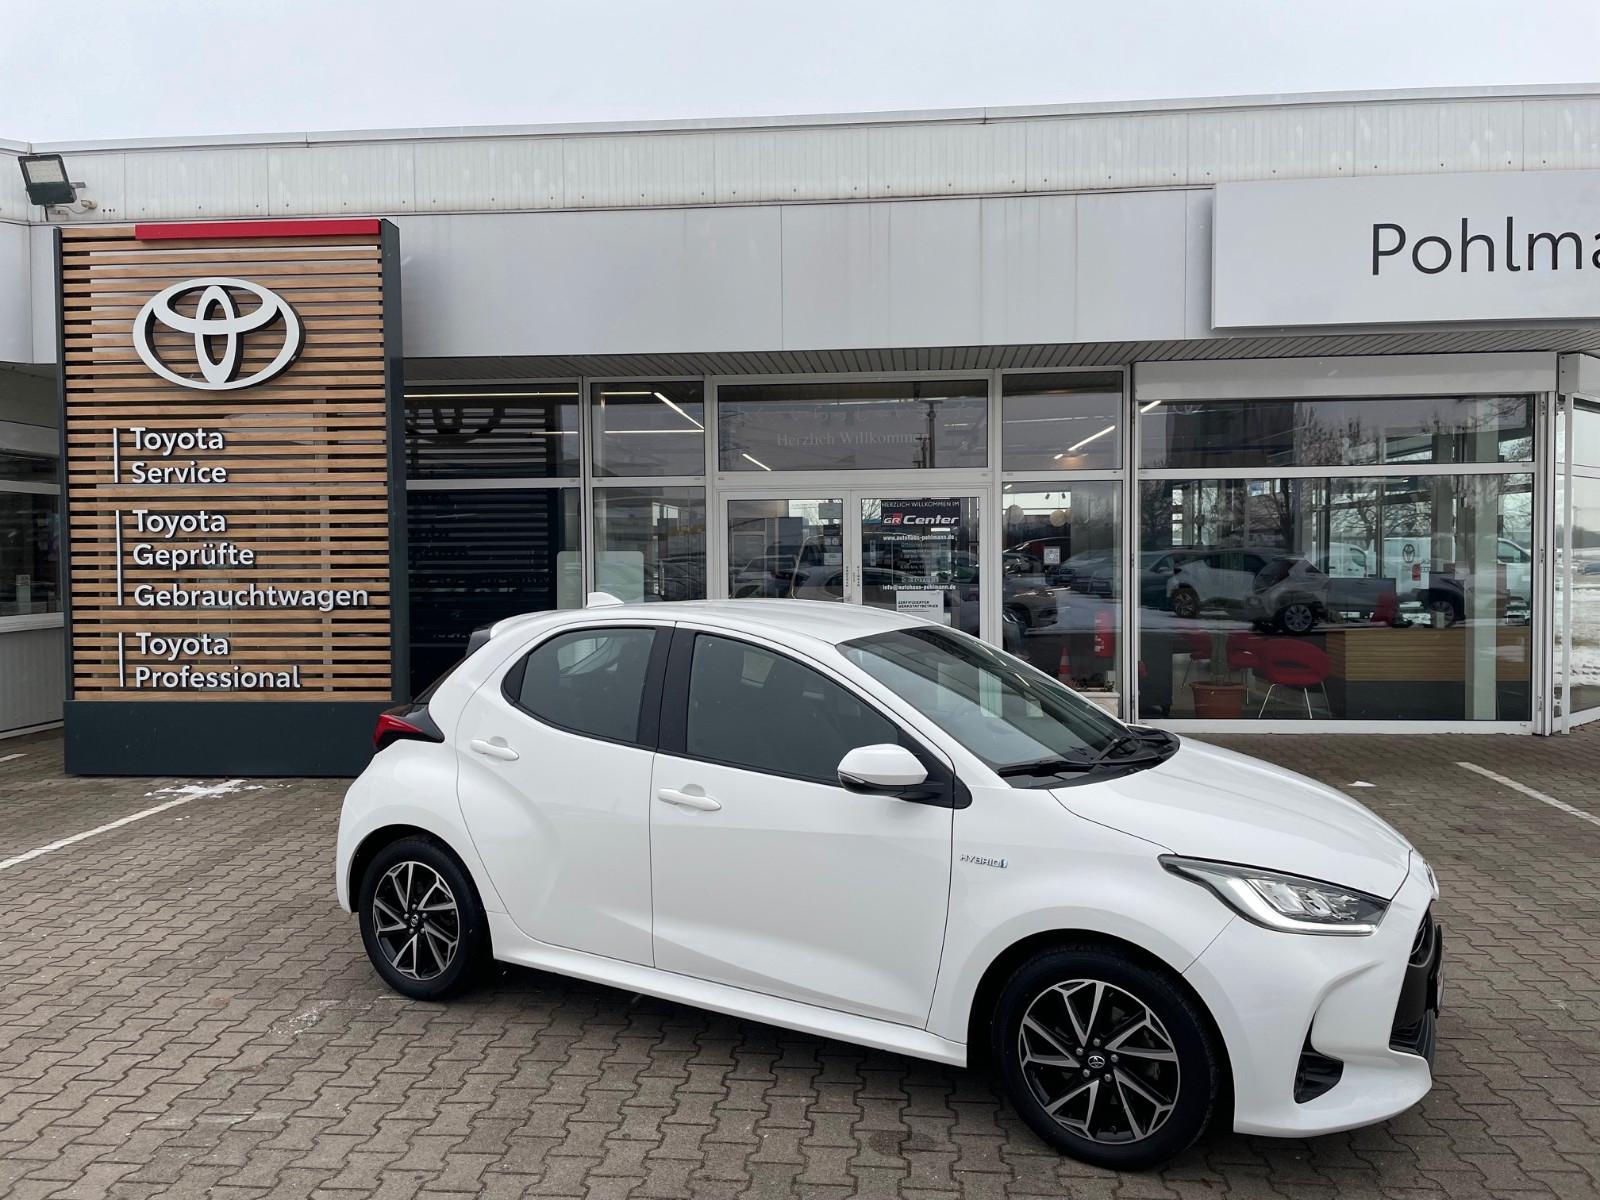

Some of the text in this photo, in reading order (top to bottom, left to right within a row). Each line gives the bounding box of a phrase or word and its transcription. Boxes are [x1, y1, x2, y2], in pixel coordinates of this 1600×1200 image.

[1372, 216, 1600, 276] Pohlm
[130, 427, 224, 455] Toyota
[777, 433, 834, 447] Herzlich
[131, 462, 227, 484] Service
[133, 509, 226, 538] Toyota
[903, 514, 960, 525] Center
[133, 543, 254, 571] Geprüfte
[134, 584, 369, 612] Gebrauchtwagen
[136, 632, 230, 661] Toyota
[135, 665, 301, 688] Professional
